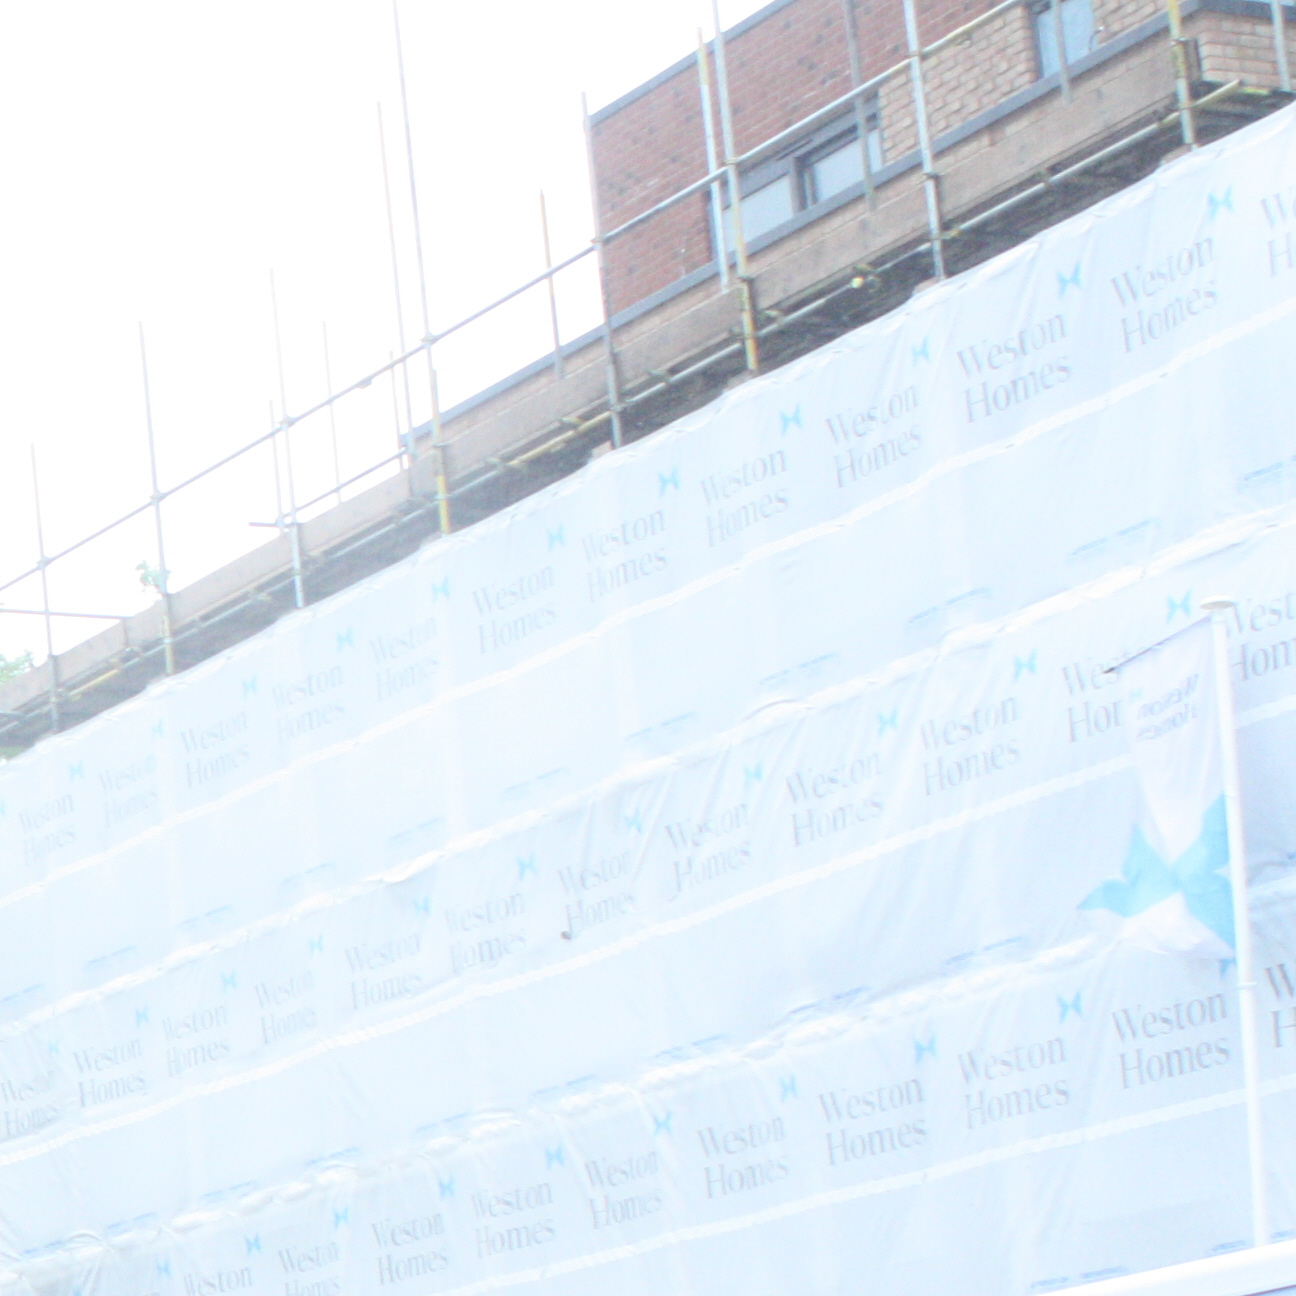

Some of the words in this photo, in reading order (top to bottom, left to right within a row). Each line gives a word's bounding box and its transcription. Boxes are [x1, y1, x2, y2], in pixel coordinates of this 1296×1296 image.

[1111, 237, 1214, 307] Weston
[1120, 280, 1217, 353] Homes
[957, 313, 1068, 379] Weston
[965, 356, 1073, 423] Homes
[825, 386, 920, 443] Weston
[700, 448, 788, 504] Weston
[834, 425, 922, 488] Homes
[581, 509, 666, 563] Weston
[707, 488, 789, 547] Homes
[473, 566, 555, 616] Weston
[587, 547, 669, 603] Homes
[370, 617, 437, 664] Weston
[478, 605, 557, 654] Homes
[272, 665, 344, 708] Weston
[375, 657, 440, 701] Homes
[180, 711, 247, 753] Weston
[277, 701, 346, 746] Homes
[920, 696, 1019, 750] Weston
[186, 744, 250, 788] Homes
[786, 753, 882, 803] Weston
[925, 739, 1020, 796] Homes
[793, 795, 884, 847] Homes
[557, 851, 630, 896] Weston
[673, 841, 751, 892] Homes
[445, 892, 525, 934] Weston
[345, 933, 420, 973] Weston
[450, 935, 526, 976] Homes
[255, 970, 314, 1009] Weston
[351, 972, 422, 1011] Homes
[162, 1005, 228, 1043] Weston
[261, 1007, 317, 1046] Homes
[1112, 992, 1228, 1043] Weston
[73, 1038, 143, 1075] Weston
[167, 1040, 231, 1078] Homes
[958, 1036, 1067, 1085] Weston
[1119, 1036, 1232, 1089] Homes
[78, 1071, 148, 1109] Homes
[818, 1077, 925, 1124] Weston
[963, 1079, 1071, 1130] Homes
[697, 1116, 786, 1159] Weston
[825, 1119, 928, 1166] Homes
[585, 1150, 658, 1189] Weston
[704, 1157, 789, 1199] Homes
[471, 1182, 554, 1220] Weston
[590, 1191, 662, 1230] Homes
[372, 1212, 444, 1250] Weston
[475, 1218, 556, 1259] Homes
[277, 1241, 340, 1275] Weston
[377, 1249, 450, 1286] Homes
